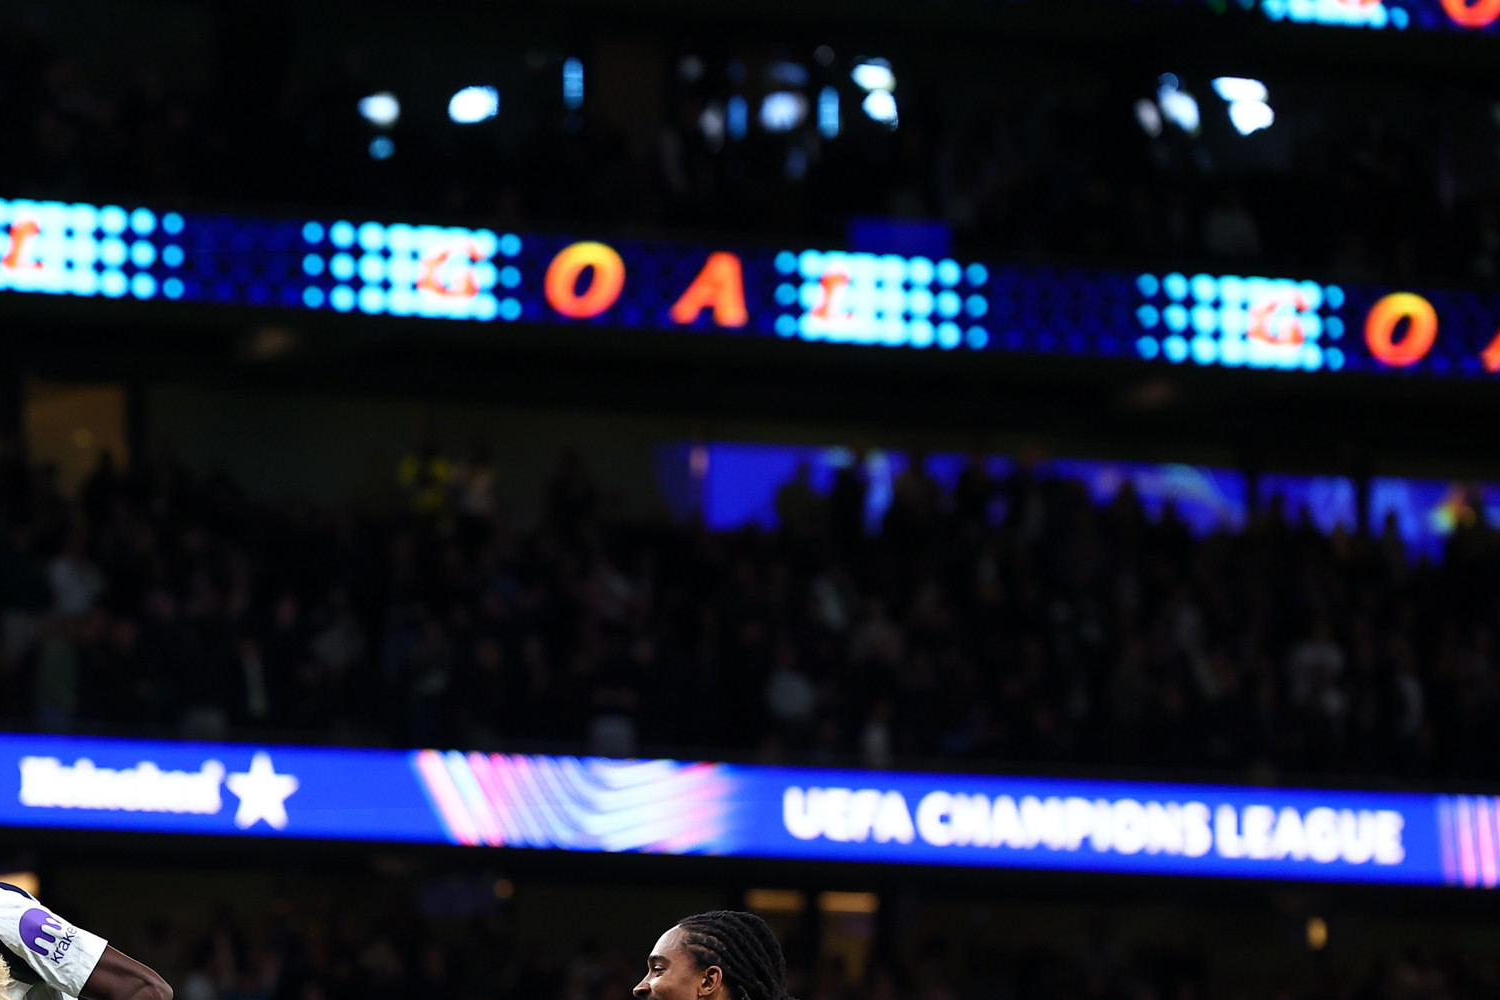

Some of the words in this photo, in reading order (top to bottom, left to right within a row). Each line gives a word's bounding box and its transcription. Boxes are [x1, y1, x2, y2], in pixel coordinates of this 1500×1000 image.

[782, 786, 916, 844] UEFA
[916, 790, 1214, 858] CHAMPIONS
[1214, 804, 1406, 865] LEAGUE
